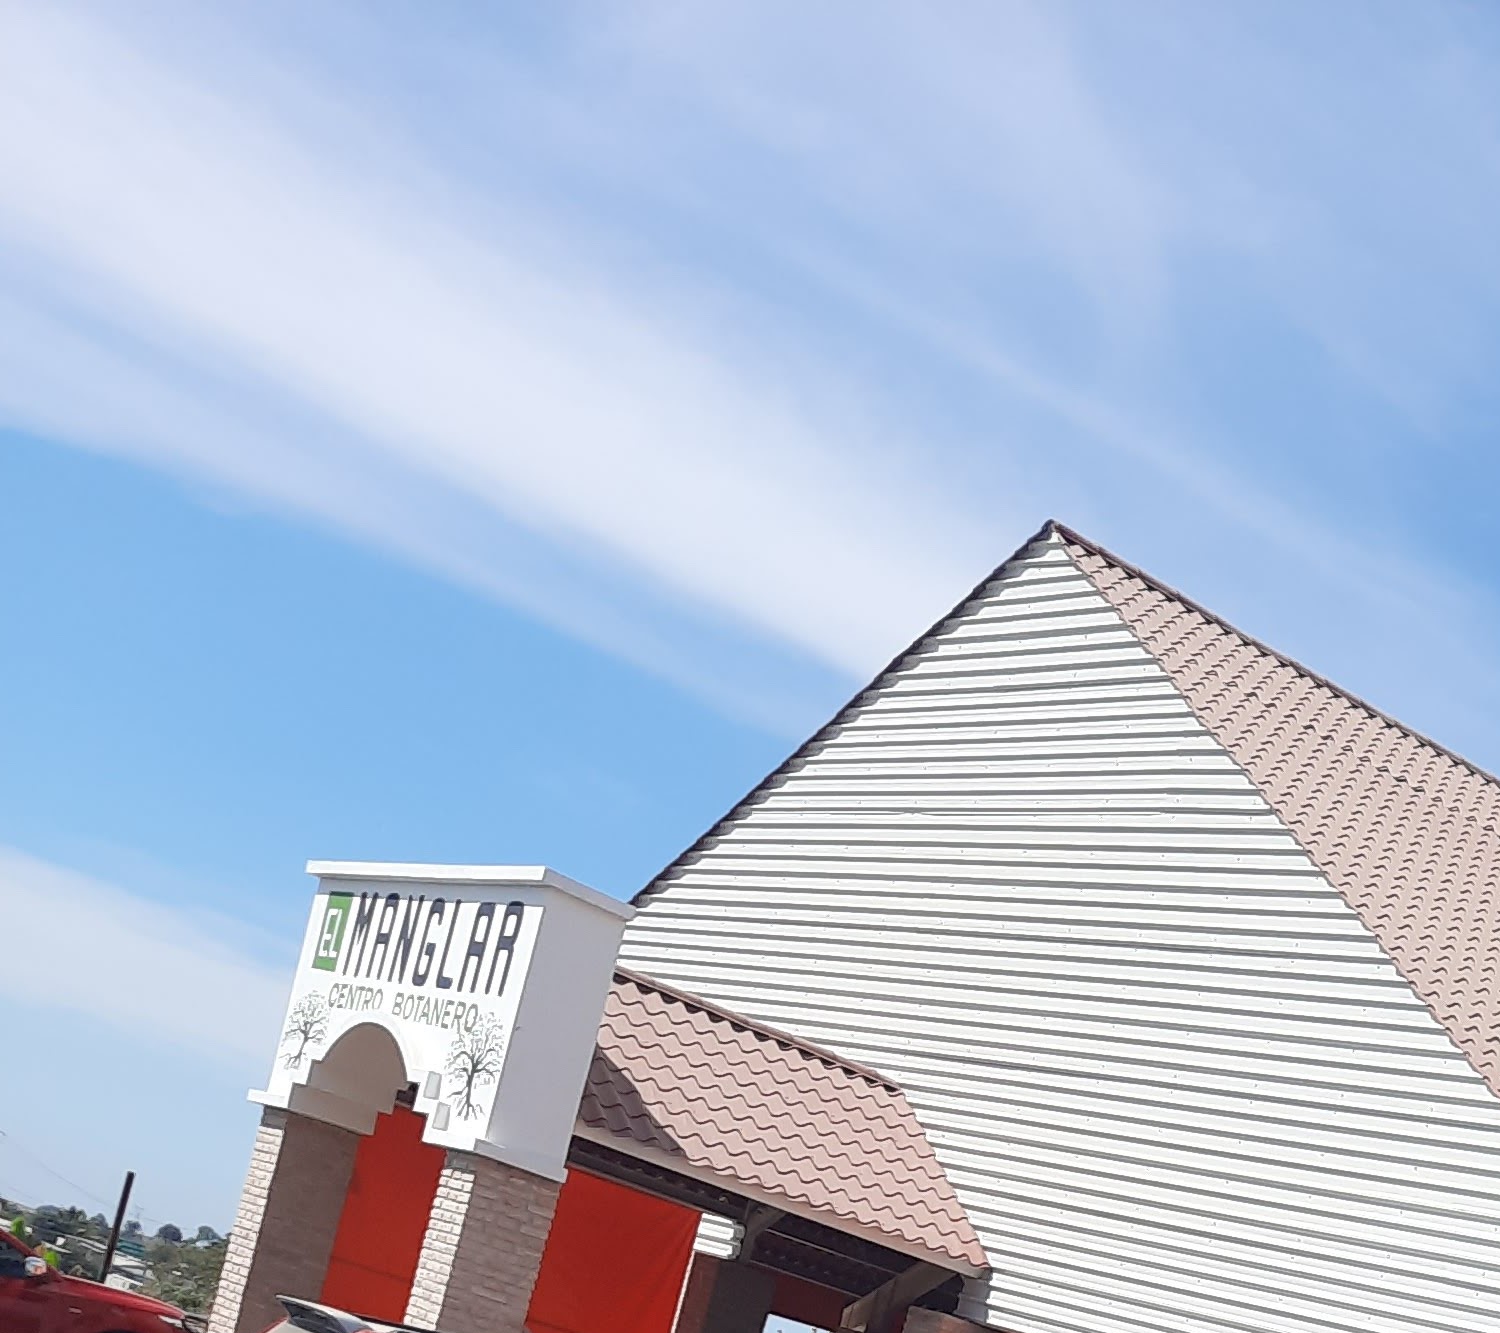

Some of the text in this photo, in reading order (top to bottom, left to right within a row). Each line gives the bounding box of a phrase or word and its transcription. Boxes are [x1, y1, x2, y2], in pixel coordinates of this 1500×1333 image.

[318, 892, 525, 997] EL MANGLAR
[328, 982, 479, 1032] CENTRO BOTANERO
